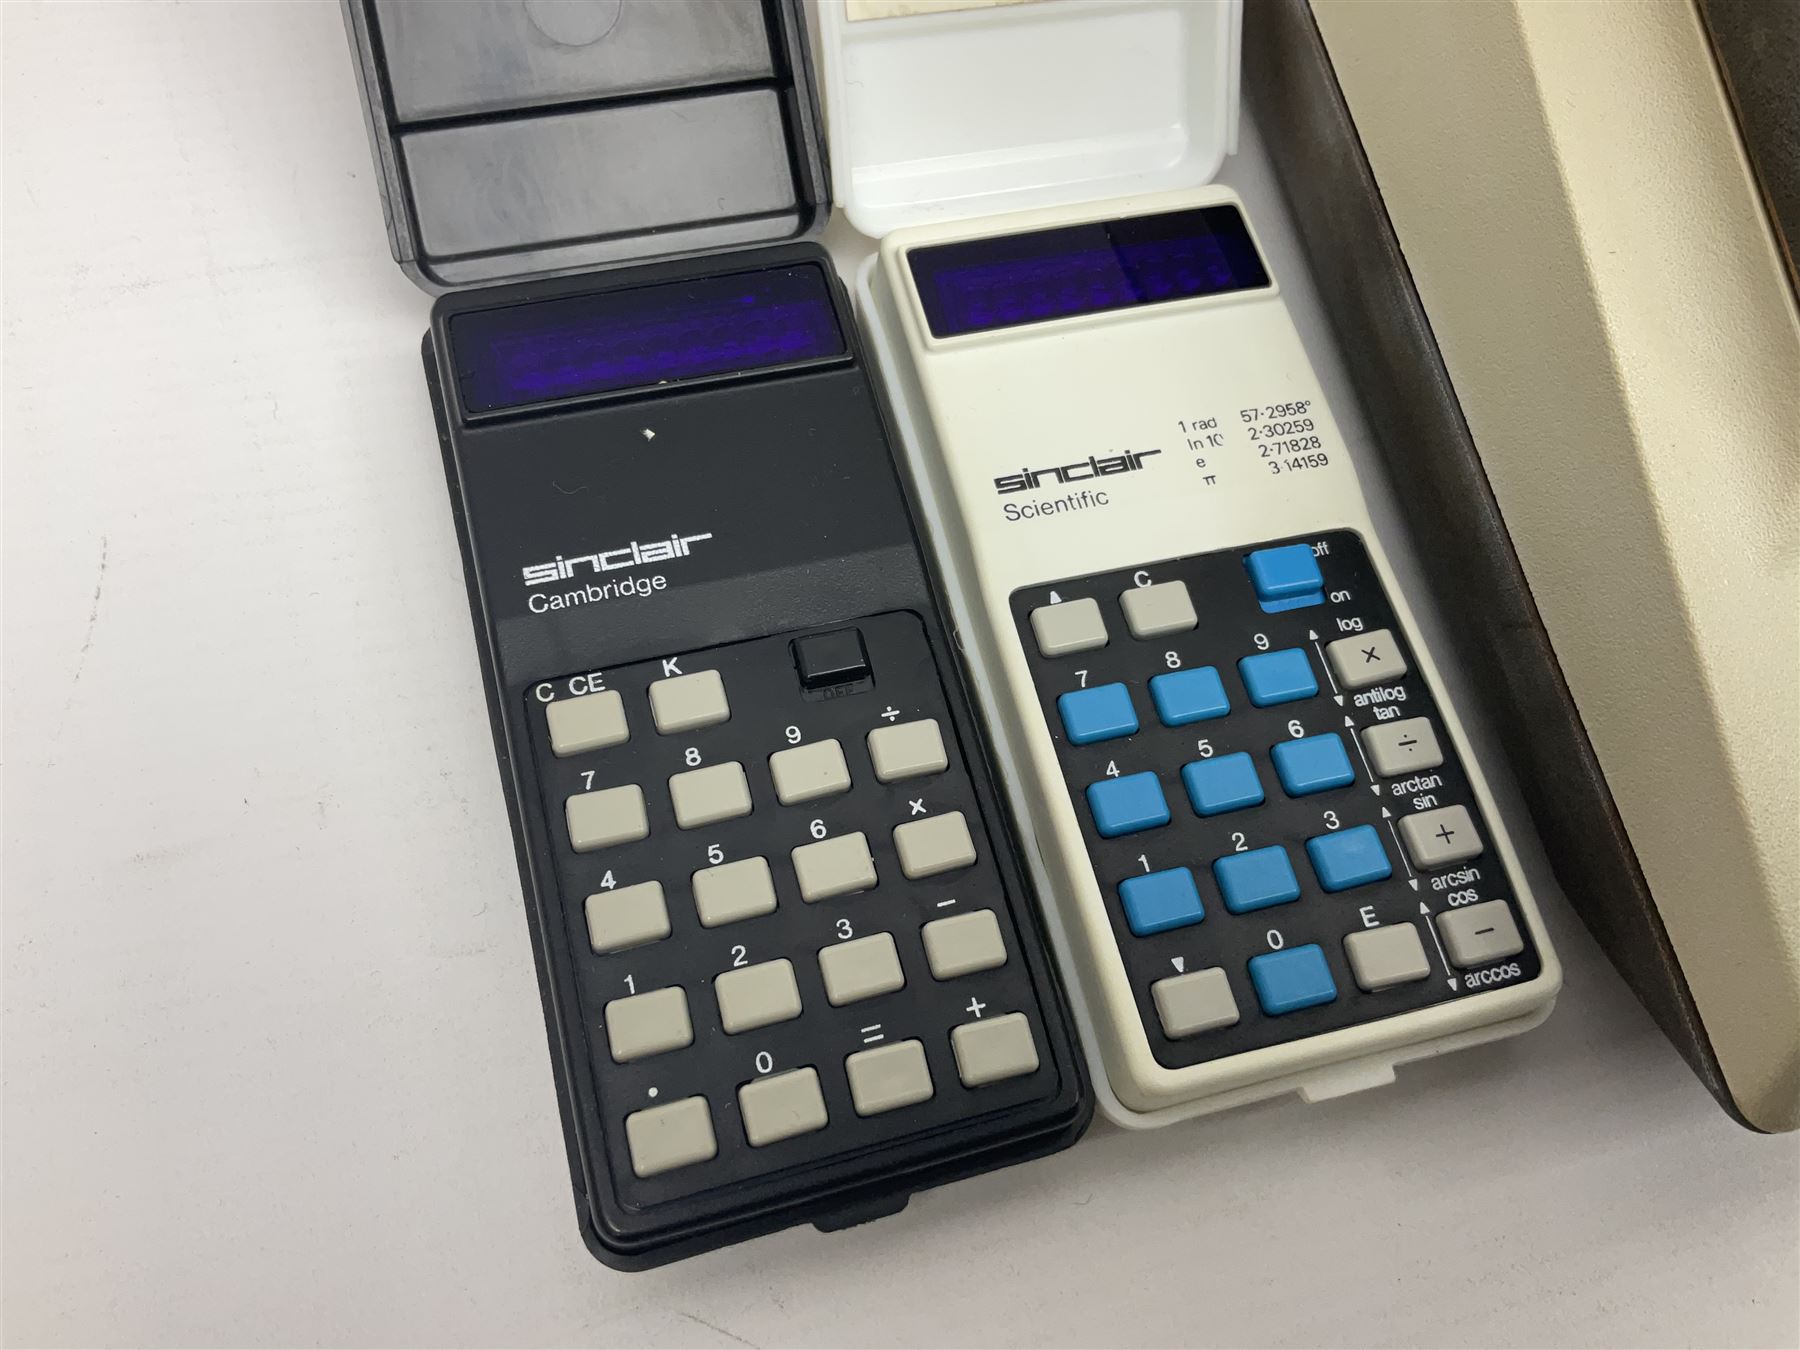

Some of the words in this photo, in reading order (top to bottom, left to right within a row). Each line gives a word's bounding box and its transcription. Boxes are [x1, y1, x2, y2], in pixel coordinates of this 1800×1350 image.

[1178, 420, 1187, 433] 1
[1192, 417, 1218, 431] rad
[993, 449, 1162, 495] sinclair
[1196, 458, 1206, 468] e
[1003, 491, 1109, 522] Scientific
[522, 532, 713, 586] sinclair
[1133, 570, 1152, 588] C
[528, 575, 667, 613] Cambridge
[1330, 589, 1351, 603] on
[1336, 616, 1363, 632] log
[1253, 633, 1270, 651] 9
[662, 657, 683, 677] K
[1165, 651, 1181, 669] 8
[535, 682, 556, 702] C
[568, 672, 607, 696] CE
[1074, 670, 1088, 688] 7
[1353, 686, 1407, 707] antilog
[1373, 705, 1401, 721] tan
[785, 725, 802, 745] 9
[1287, 719, 1305, 739] 6
[684, 747, 702, 767] 8
[1198, 739, 1214, 758] 5
[1106, 760, 1121, 778] 4
[580, 770, 596, 790] 7
[1391, 774, 1443, 796] arctan
[1412, 793, 1438, 810] sin
[809, 819, 827, 839] 6
[1323, 810, 1341, 830] 3
[1231, 832, 1249, 852] 2
[707, 843, 725, 864] 5
[1137, 854, 1150, 872] 1
[600, 870, 617, 889] 4
[1430, 866, 1481, 891] arcsin
[1447, 888, 1479, 907] cos
[1359, 905, 1380, 928] E
[835, 918, 853, 939] 3
[1266, 929, 1285, 950] 0
[730, 944, 749, 967] 2
[623, 974, 636, 995] 1
[1464, 962, 1522, 988] arccos
[755, 1051, 774, 1074] 0
